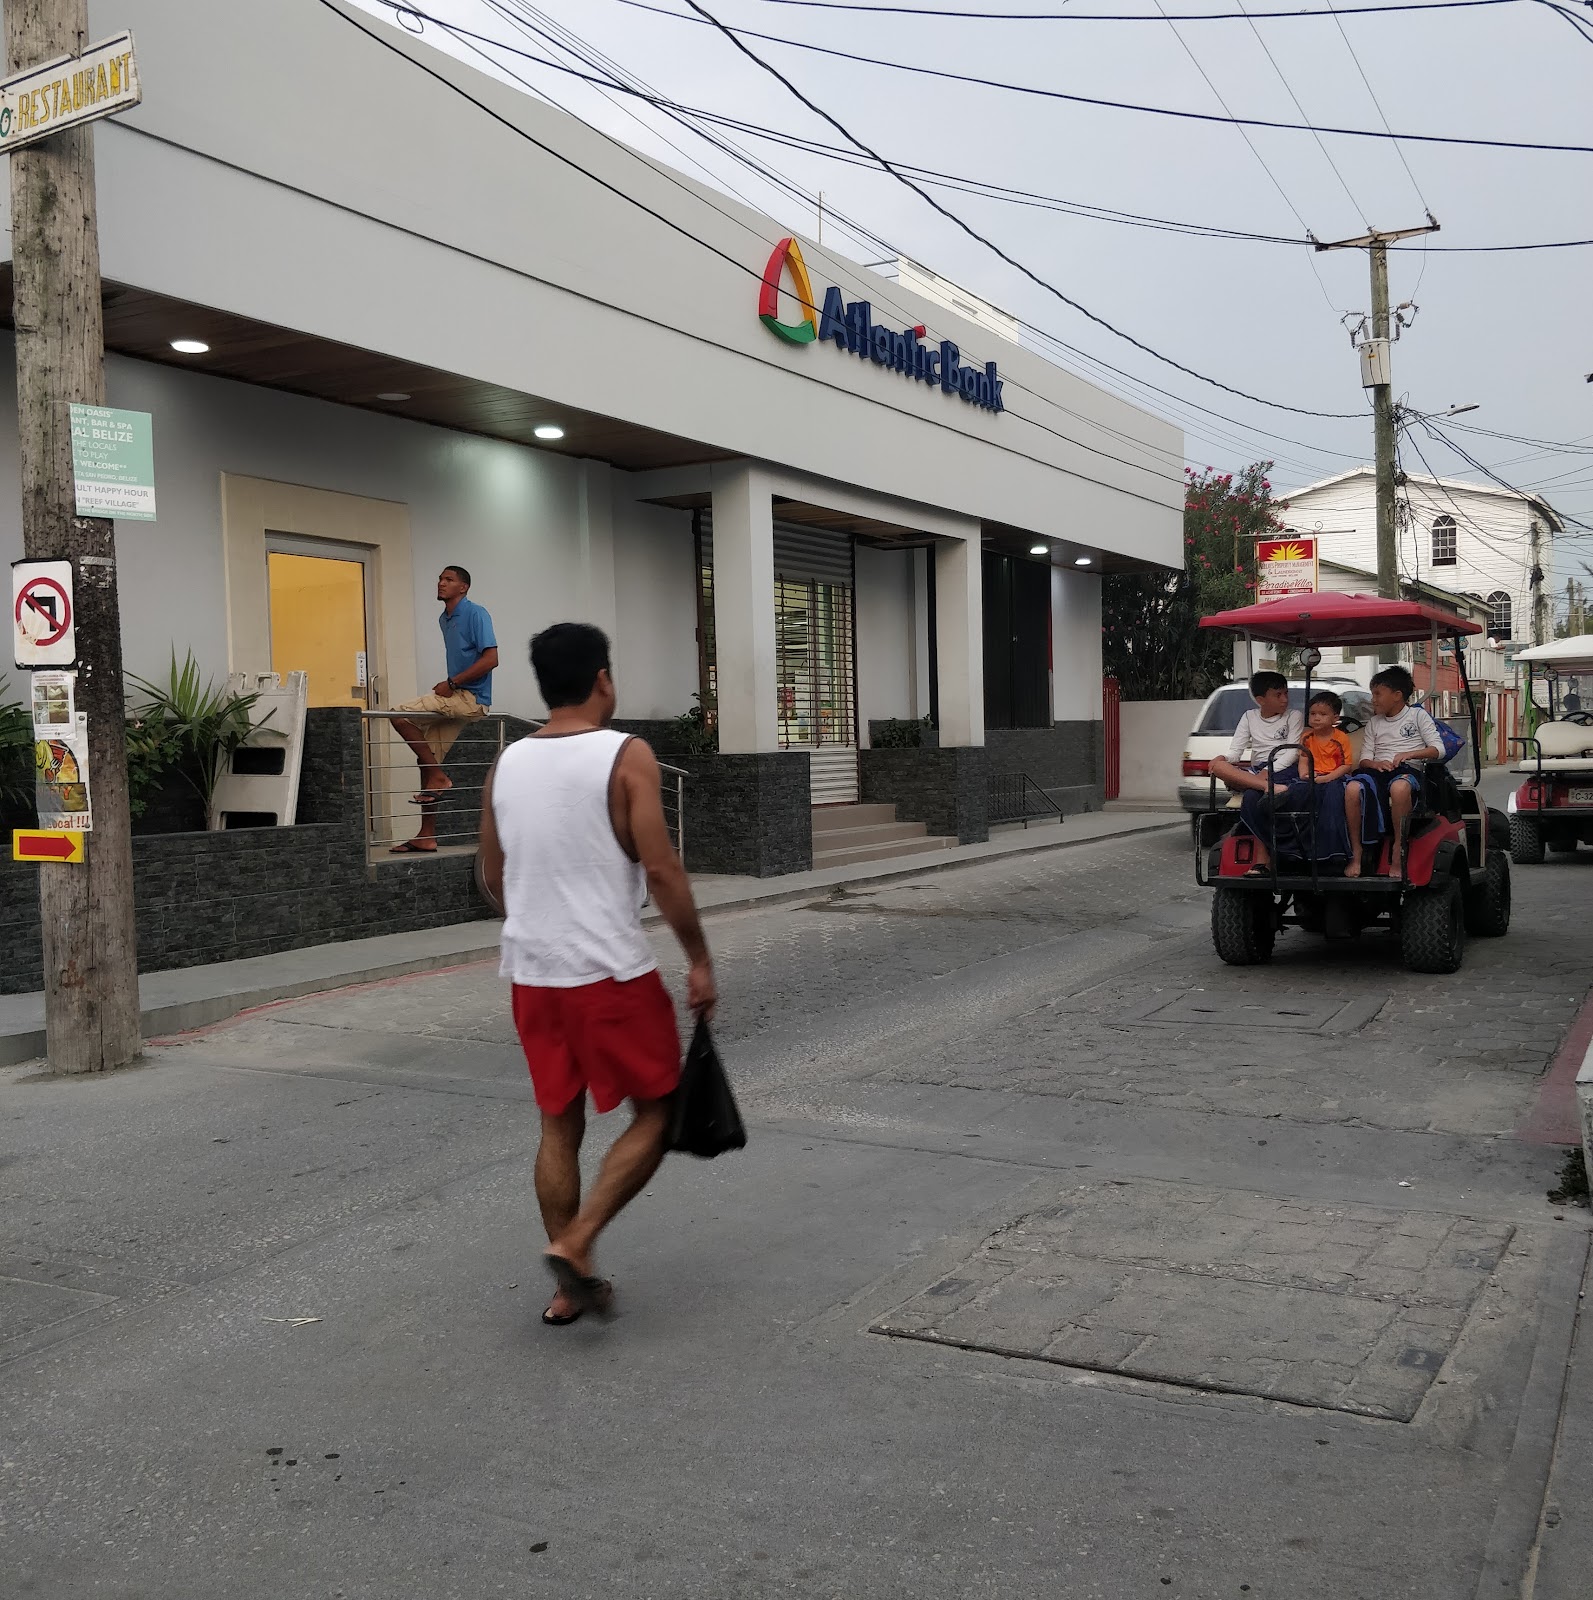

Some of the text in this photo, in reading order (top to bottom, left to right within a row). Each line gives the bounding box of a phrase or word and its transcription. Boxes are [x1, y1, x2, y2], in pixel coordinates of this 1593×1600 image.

[18, 52, 131, 131] RESTAURANT
[818, 286, 1004, 413] Atlantic Bank
[91, 419, 108, 427] BAR
[117, 422, 133, 430] SPA
[72, 427, 133, 443] AL BELIZE
[88, 441, 117, 451] LOCALS
[91, 451, 108, 460] PLAY
[76, 484, 149, 498] ULT HAPPY HOUR
